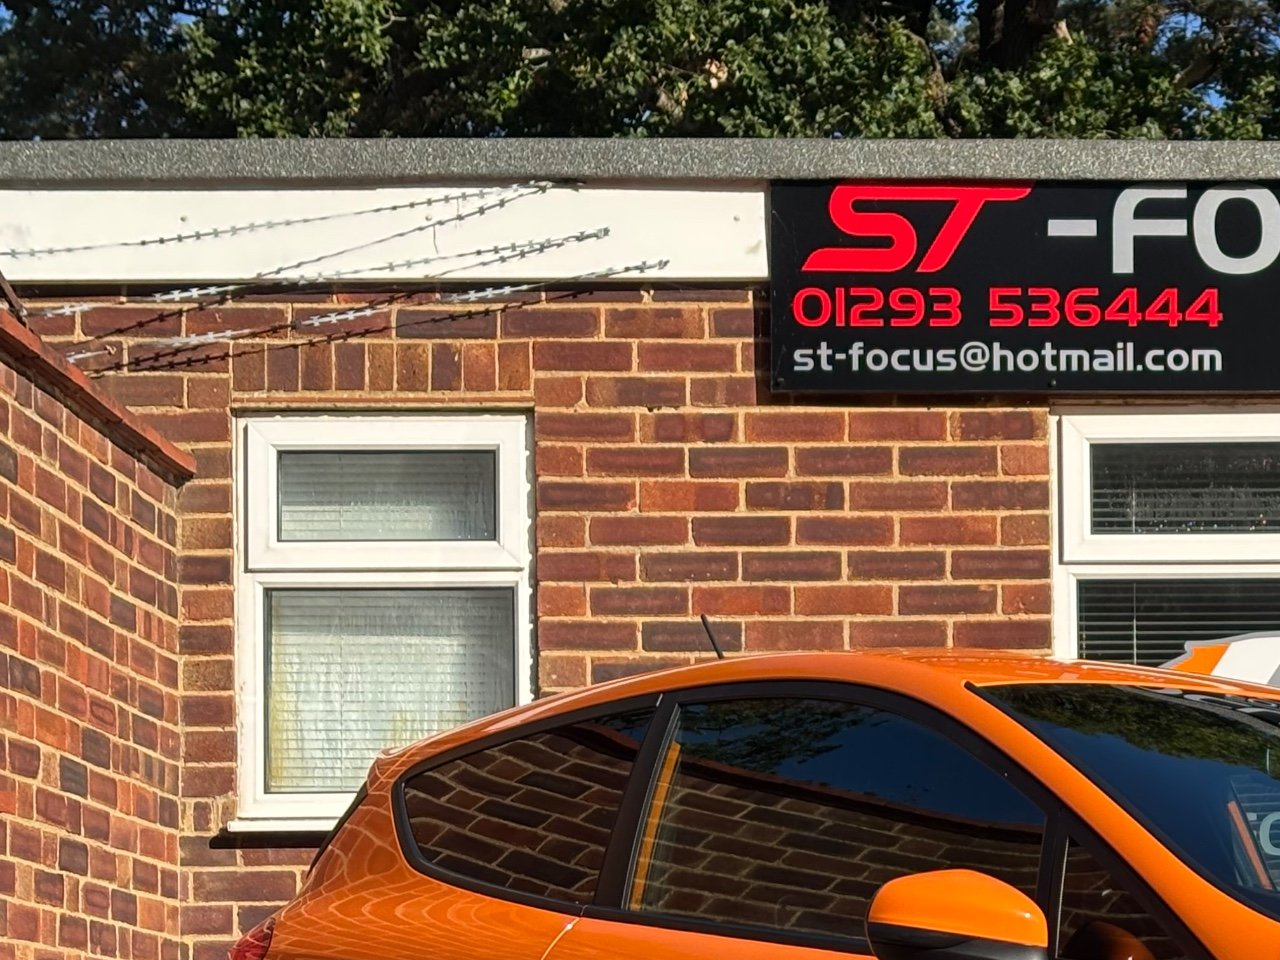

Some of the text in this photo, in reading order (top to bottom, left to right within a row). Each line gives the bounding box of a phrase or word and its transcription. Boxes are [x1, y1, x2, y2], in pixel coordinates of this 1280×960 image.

[801, 182, 1032, 273] ST
[792, 287, 1223, 328] 01293 536444
[793, 341, 1223, 372] st-focus@hotmail.com
